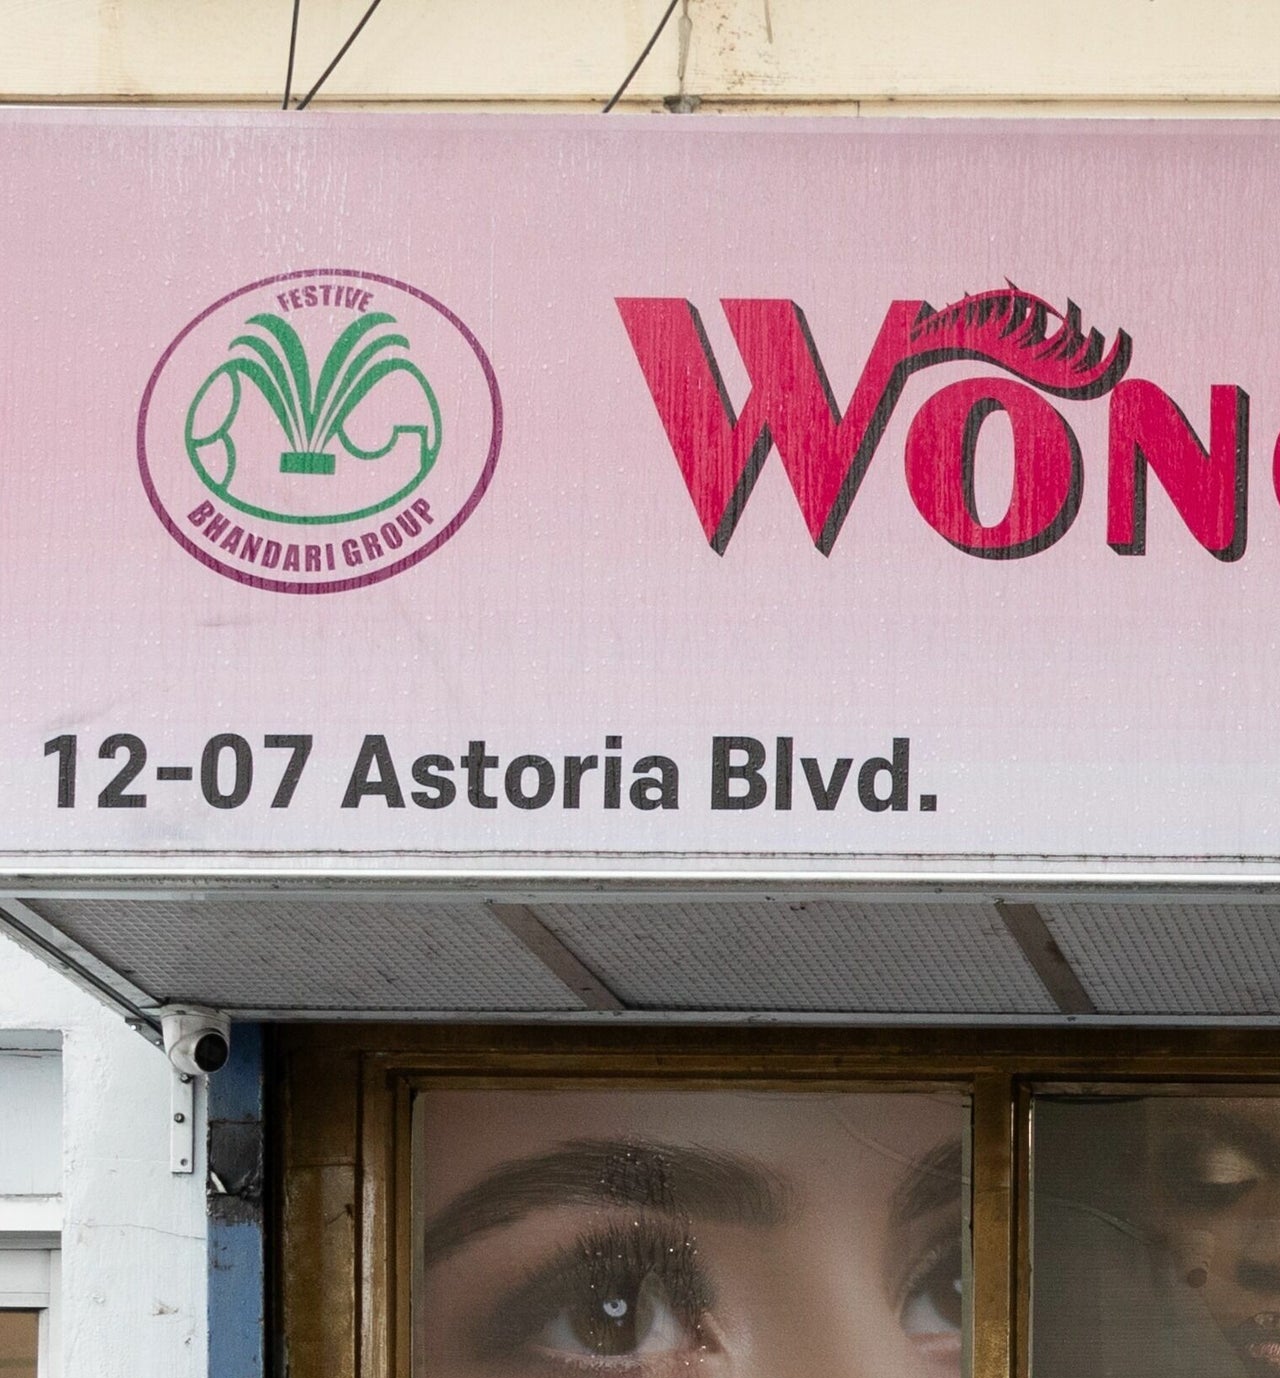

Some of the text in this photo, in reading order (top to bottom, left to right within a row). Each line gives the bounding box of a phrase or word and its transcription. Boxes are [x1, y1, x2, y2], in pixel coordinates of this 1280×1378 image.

[276, 285, 374, 313] FESTIVE
[187, 497, 435, 572] BHANDARI GROUP
[43, 733, 938, 813] 12-07 Astoria Blvd.
